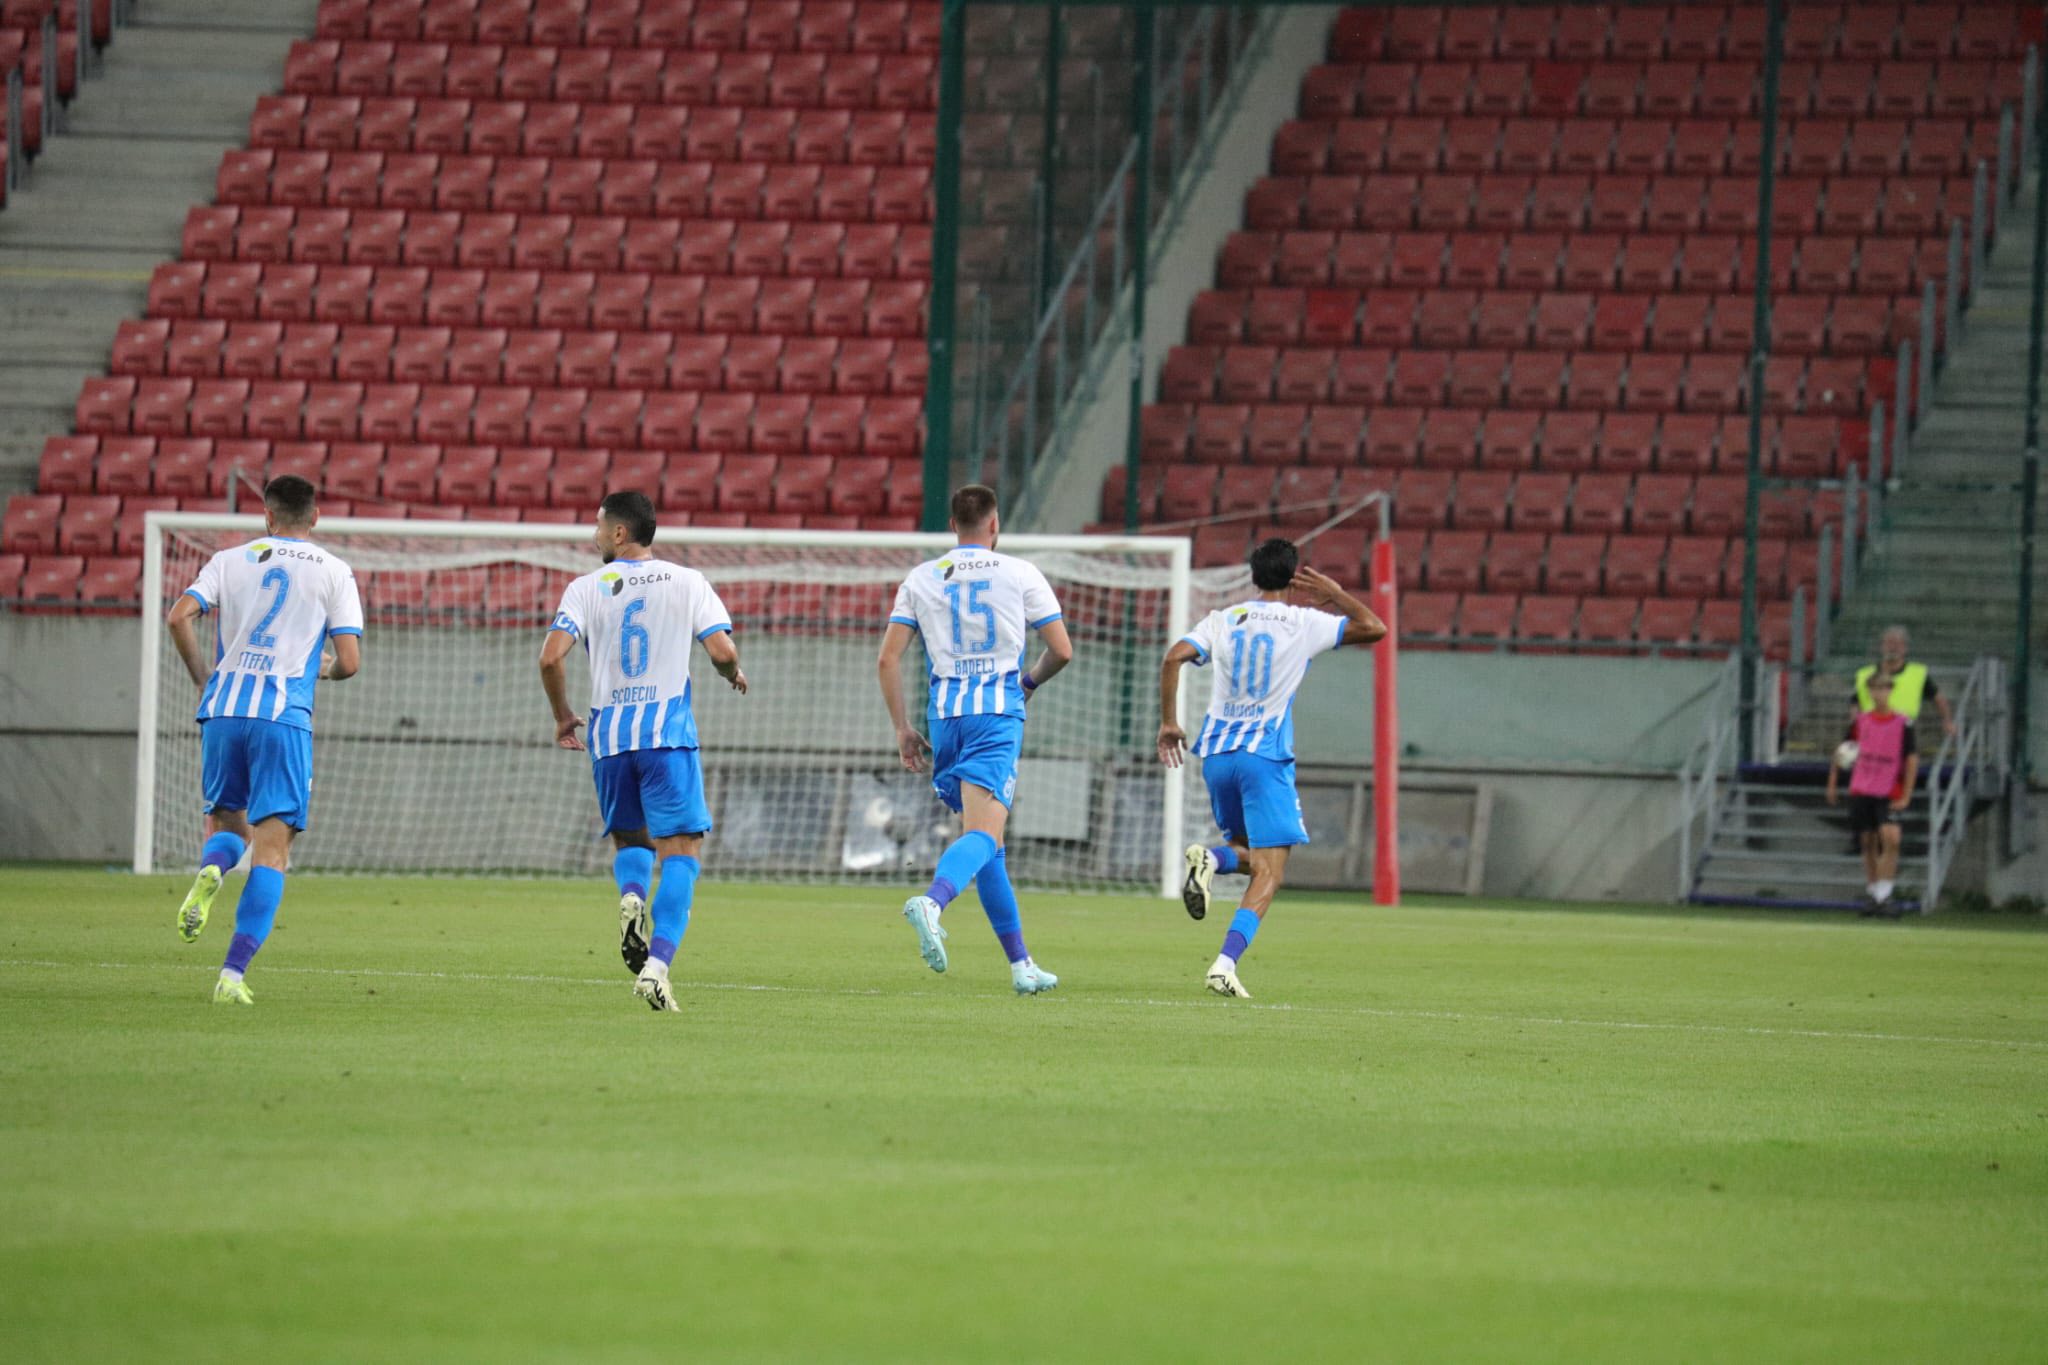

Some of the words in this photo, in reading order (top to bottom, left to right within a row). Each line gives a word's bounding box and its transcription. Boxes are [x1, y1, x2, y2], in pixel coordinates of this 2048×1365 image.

[277, 548, 324, 564] OSCAR
[958, 560, 1000, 571] OSCAR
[628, 572, 671, 586] OSCAR
[249, 567, 290, 648] 2
[944, 579, 997, 655] 15
[1250, 612, 1287, 622] OSCAR
[621, 598, 649, 679] 6
[954, 657, 994, 674] BADELJ
[1231, 629, 1274, 699] 10
